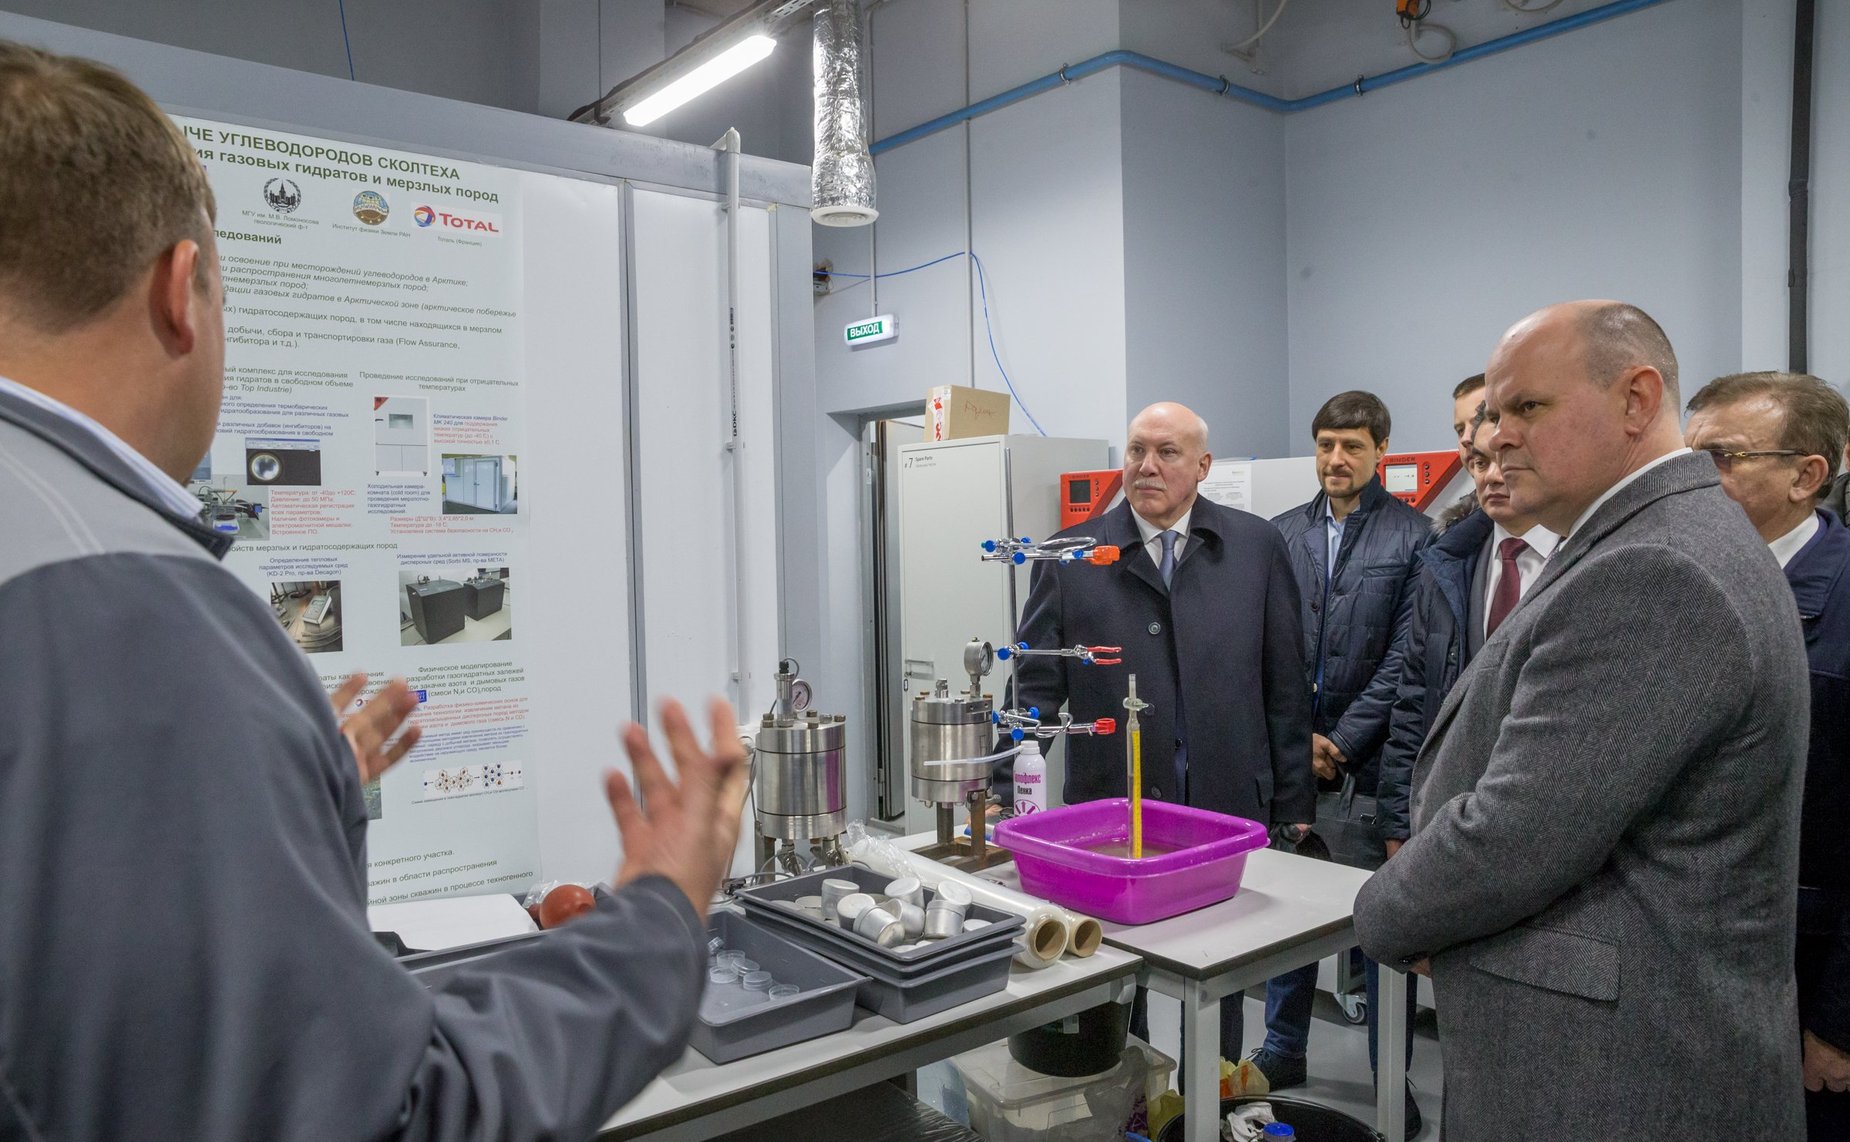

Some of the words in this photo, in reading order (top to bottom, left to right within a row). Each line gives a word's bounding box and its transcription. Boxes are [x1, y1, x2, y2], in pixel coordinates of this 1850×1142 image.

[219, 131, 373, 166] УГЛЕВОДОРОДОВ
[378, 156, 460, 180] СКОЛТЕХА
[220, 152, 290, 171] газовых
[295, 163, 368, 182] гидратов
[373, 175, 382, 185] и
[386, 177, 452, 195] мерзлых
[456, 187, 499, 204] пород
[439, 213, 499, 233] TOTAL
[228, 255, 270, 266] освоение
[273, 260, 289, 269] при
[291, 263, 361, 276] месторождений
[363, 269, 423, 282] углеводородов
[230, 266, 311, 280] распространения
[254, 288, 290, 298] газовых
[292, 292, 335, 302] гидратов
[344, 295, 399, 308] Арктической
[238, 306, 328, 320] гидратосодержащих
[384, 319, 407, 327] числе
[267, 328, 293, 338] сбора
[304, 332, 375, 344] транспортировки
[850, 323, 880, 338] ВЫХОД
[359, 371, 403, 381] Проведение
[405, 374, 454, 384] исследований
[220, 408, 281, 416] идратообразования
[376, 542, 398, 551] пород
[374, 854, 422, 868] конкретного
[399, 870, 431, 882] области
[432, 859, 498, 877] распространения
[388, 893, 409, 902] зоны
[410, 887, 442, 899] скважин
[450, 879, 485, 892] процессе
[487, 871, 534, 884] техногенного
